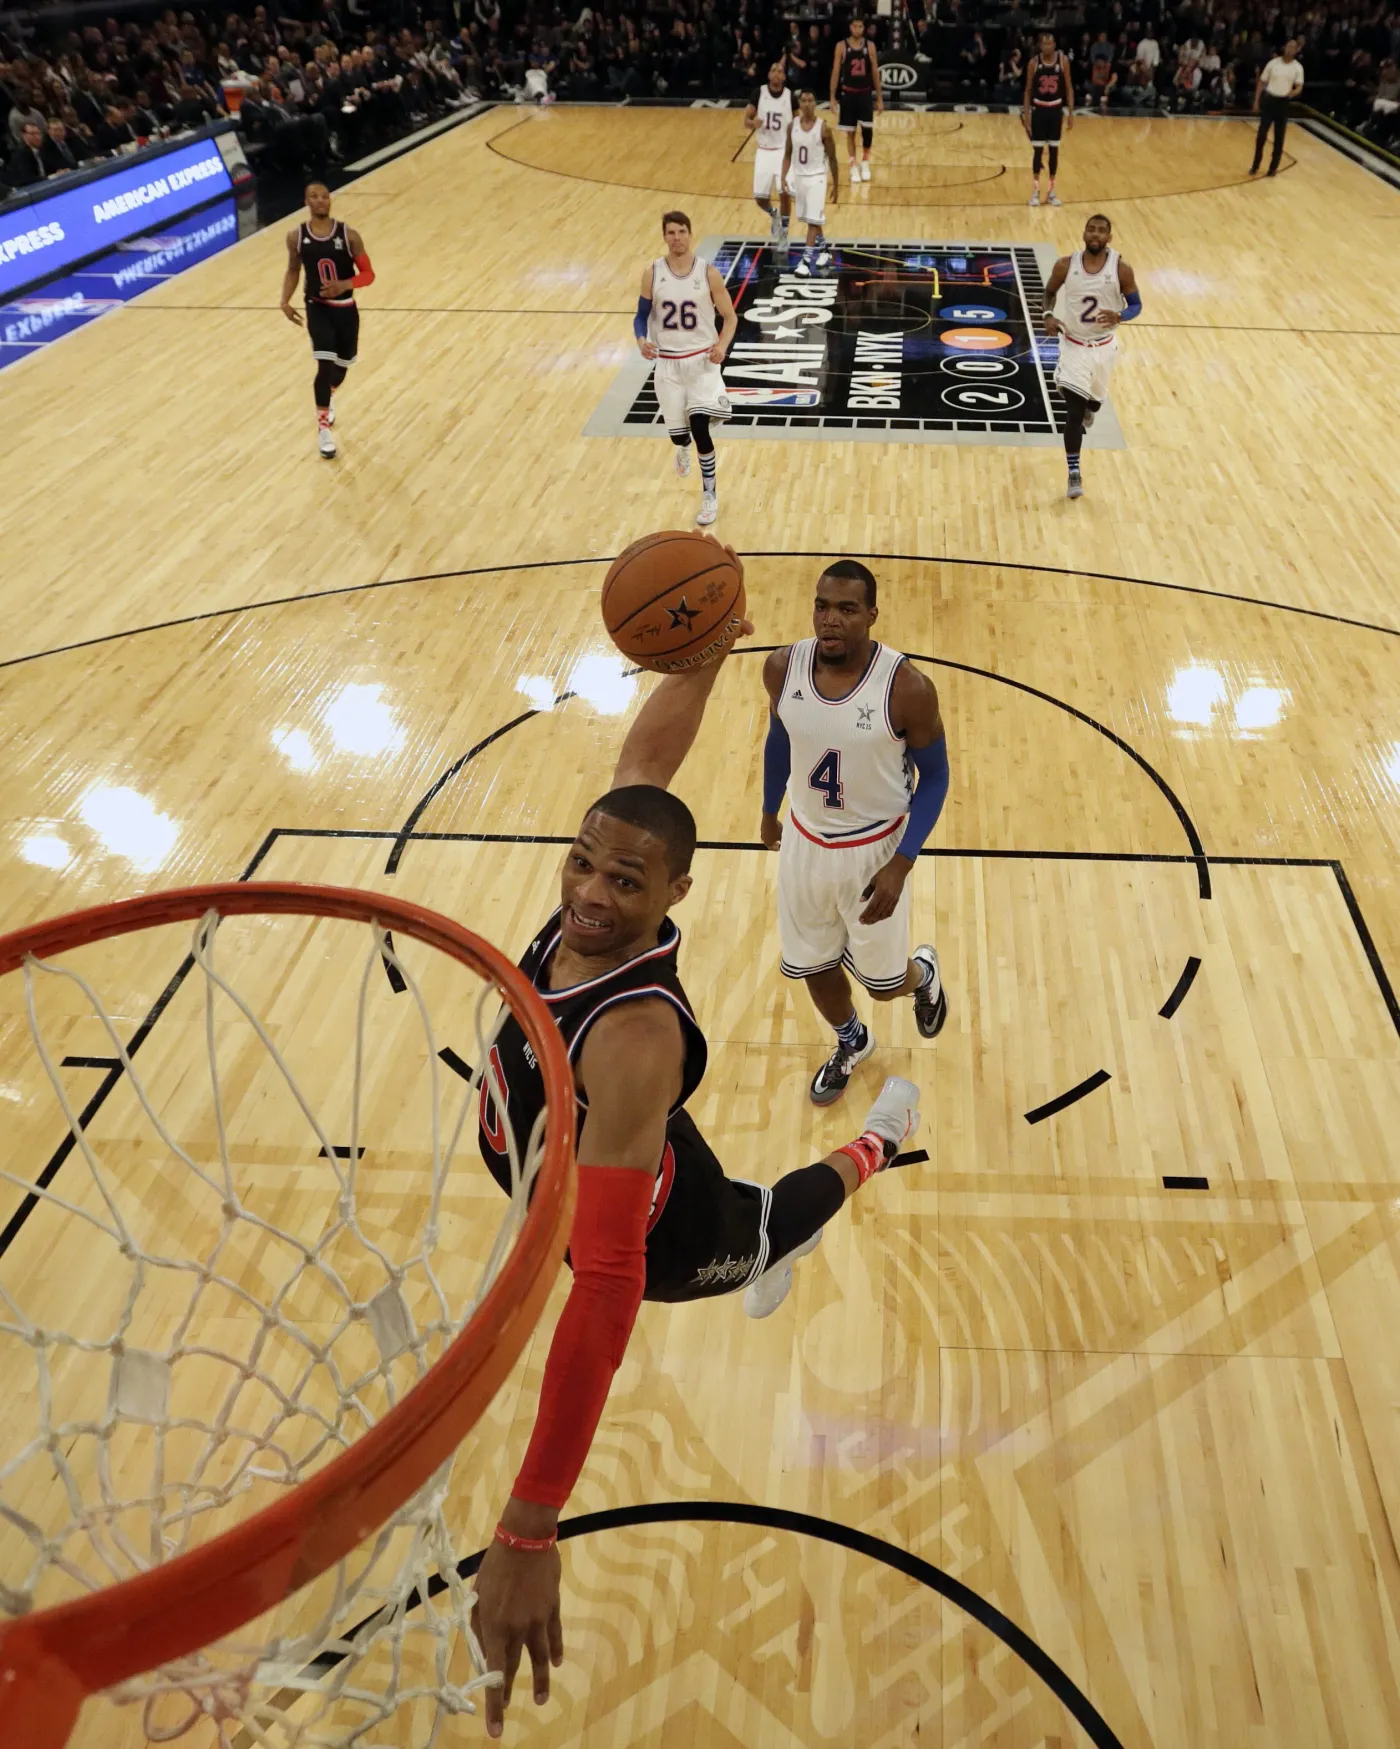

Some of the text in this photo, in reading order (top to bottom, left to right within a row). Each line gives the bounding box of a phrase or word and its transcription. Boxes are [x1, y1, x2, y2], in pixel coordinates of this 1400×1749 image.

[851, 58, 866, 76] 21
[881, 68, 910, 83] KIA
[1039, 75, 1059, 94] 35
[765, 110, 783, 131] 15
[798, 145, 809, 165] 0
[93, 156, 223, 224] AMERICAN EXPRESS
[317, 258, 338, 288] 0
[662, 300, 698, 330] 26
[1081, 295, 1098, 323] 2
[722, 273, 840, 386] All Star
[807, 747, 845, 810] 4
